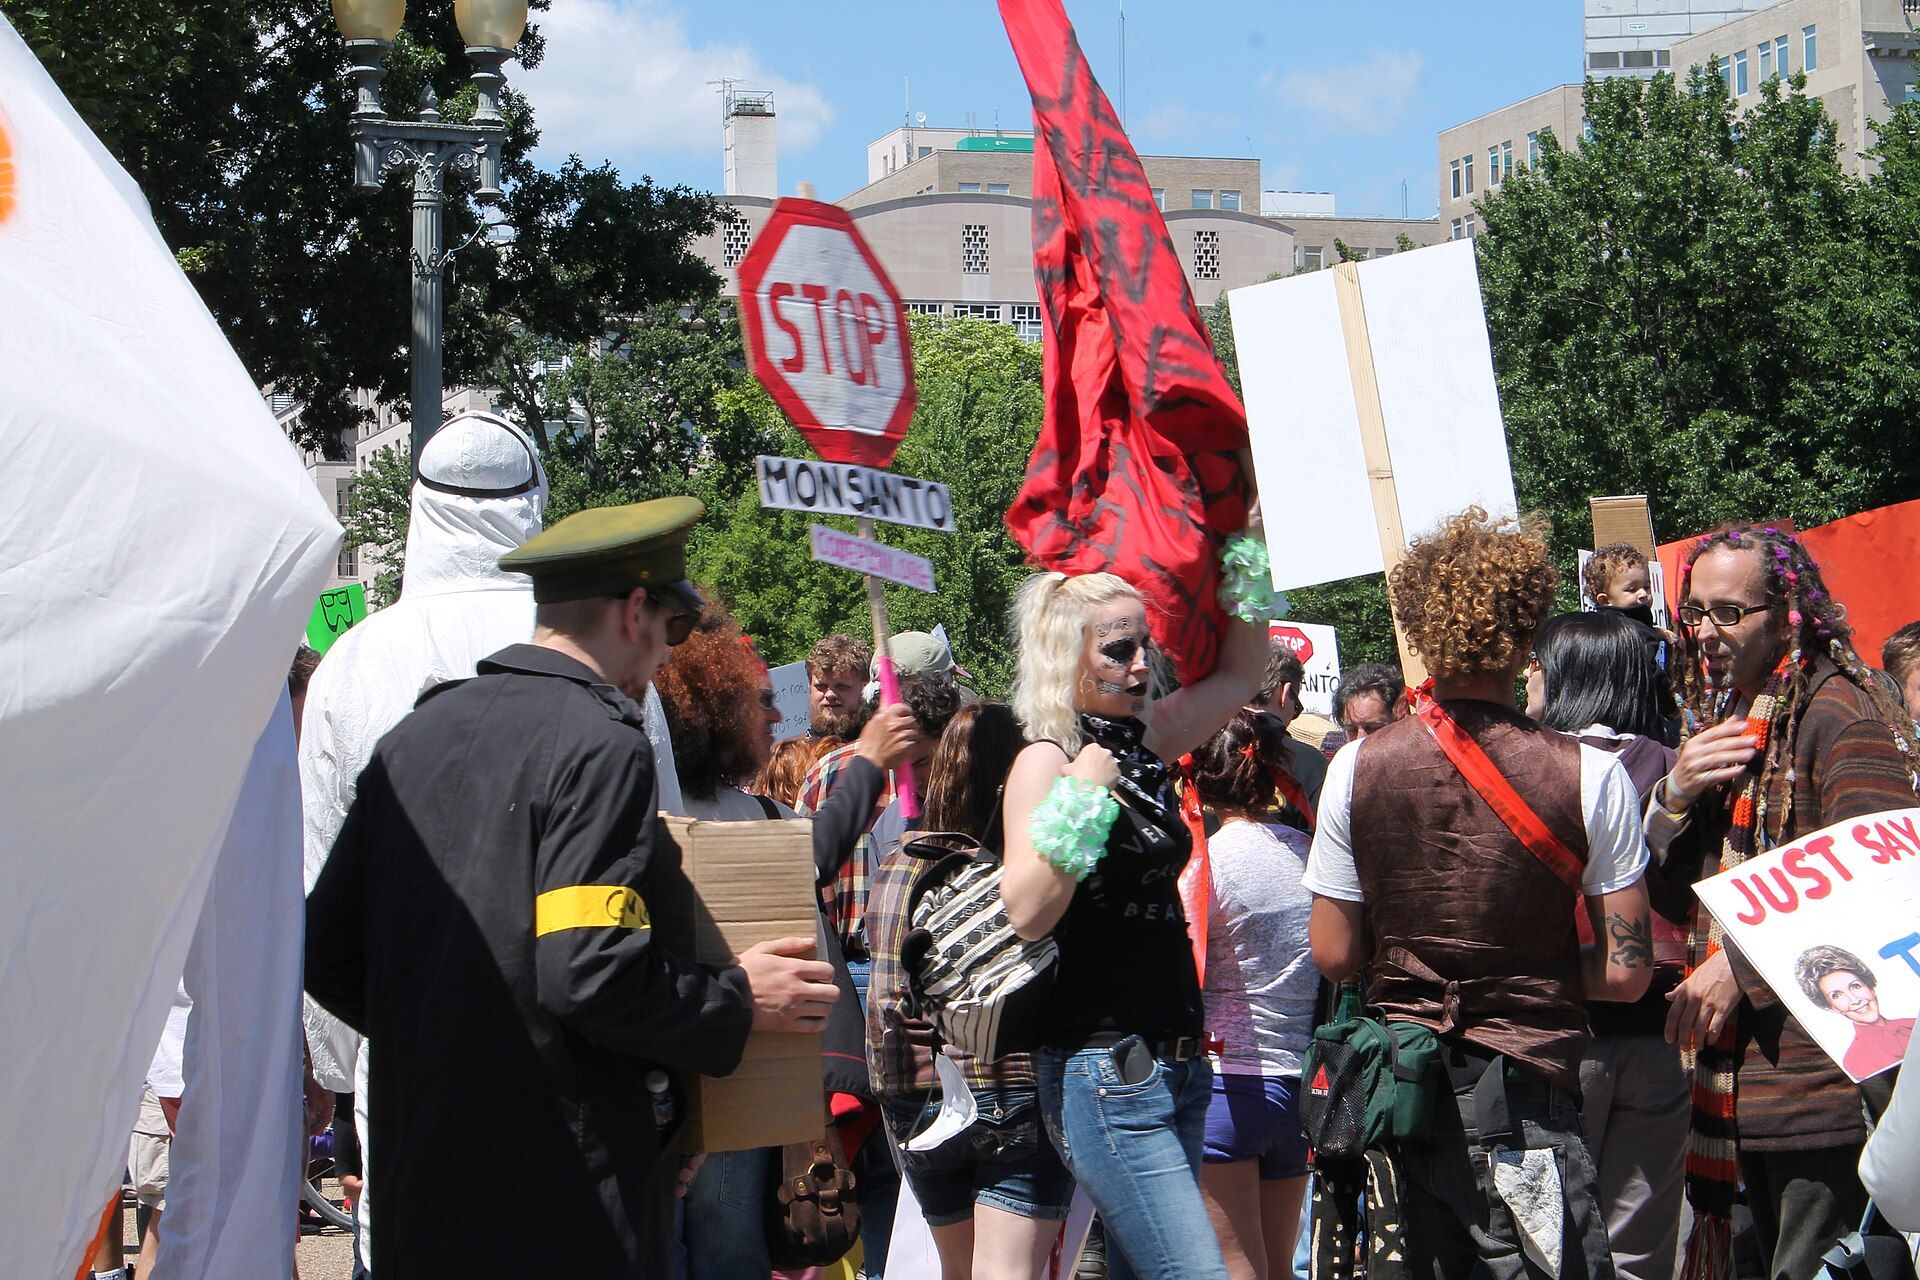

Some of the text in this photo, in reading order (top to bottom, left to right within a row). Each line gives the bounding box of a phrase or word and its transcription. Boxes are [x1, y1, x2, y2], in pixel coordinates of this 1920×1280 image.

[770, 282, 887, 388] STOP
[764, 459, 947, 528] MONSANTO
[774, 686, 786, 703] OT
[1730, 816, 1920, 926] JUST SAY
[1123, 902, 1184, 920] BEA
